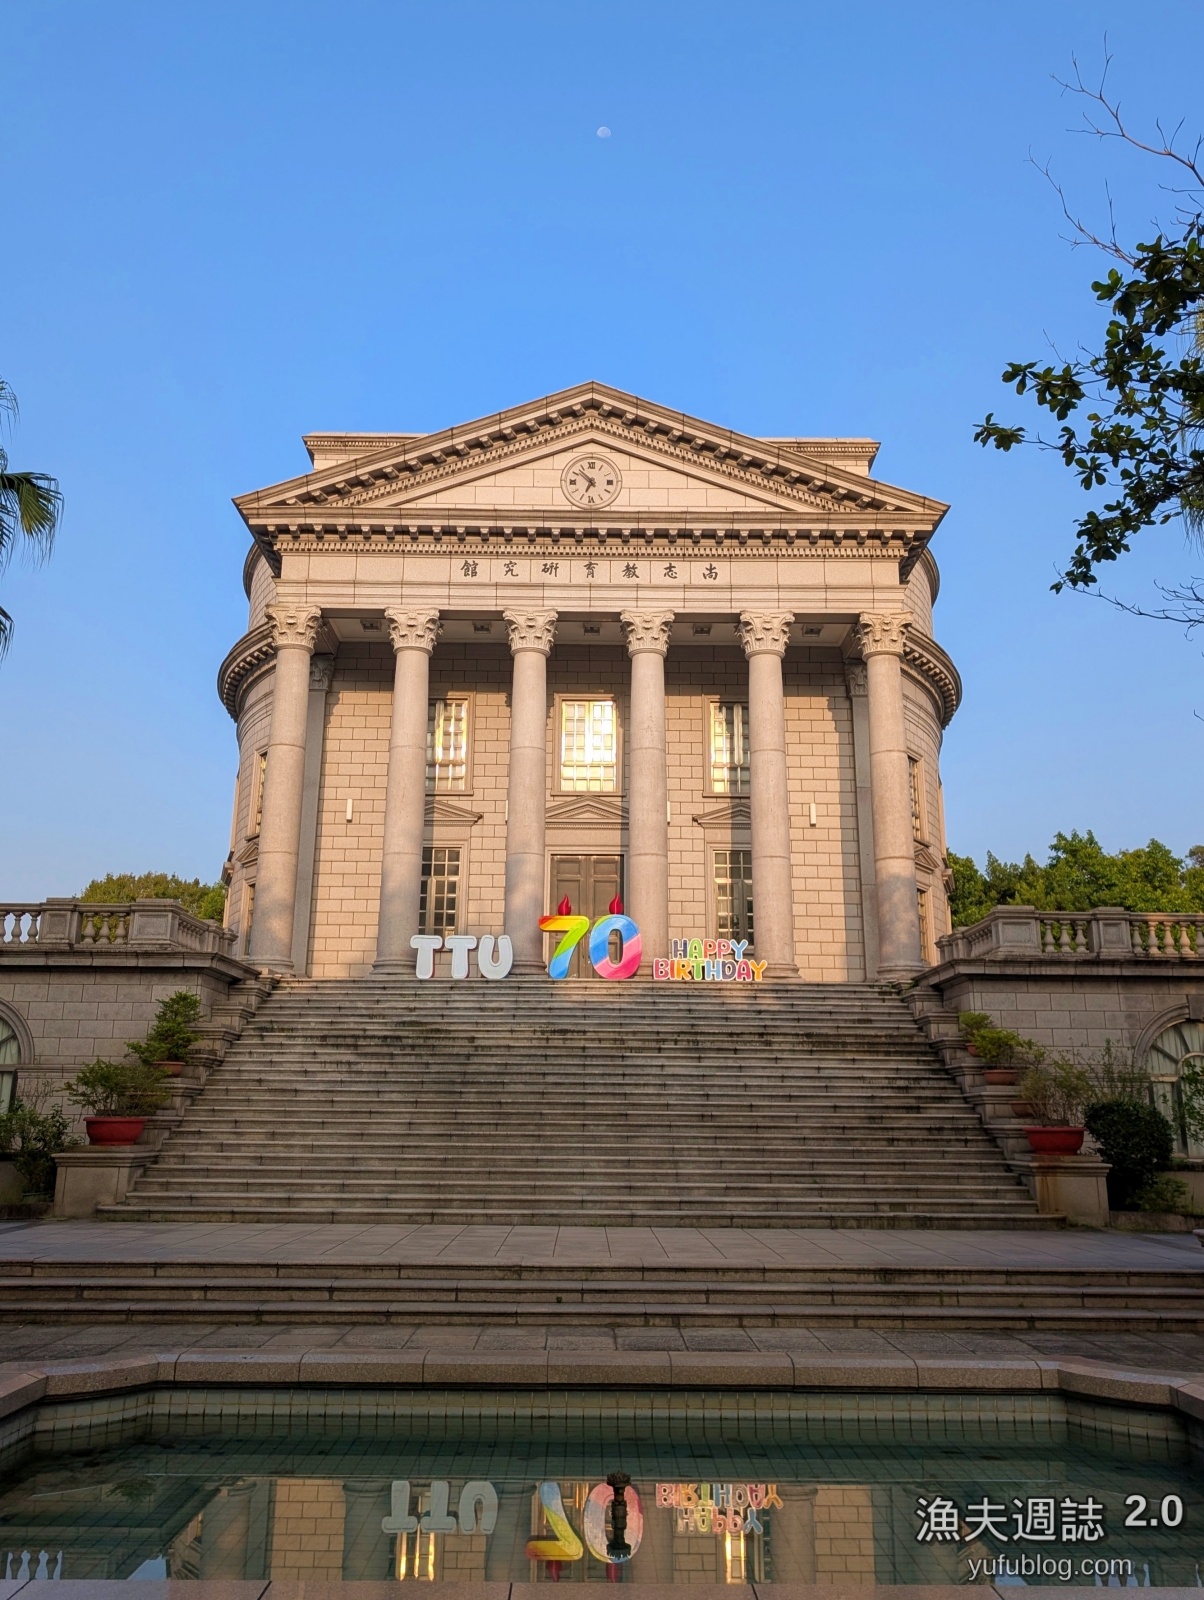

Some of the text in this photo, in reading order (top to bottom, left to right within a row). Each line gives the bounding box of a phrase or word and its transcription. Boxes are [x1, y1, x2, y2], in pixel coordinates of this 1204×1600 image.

[410, 934, 514, 980] TTU
[538, 914, 642, 980] 70
[672, 938, 749, 960] HAPPY
[653, 957, 768, 982] BIRTHDAY
